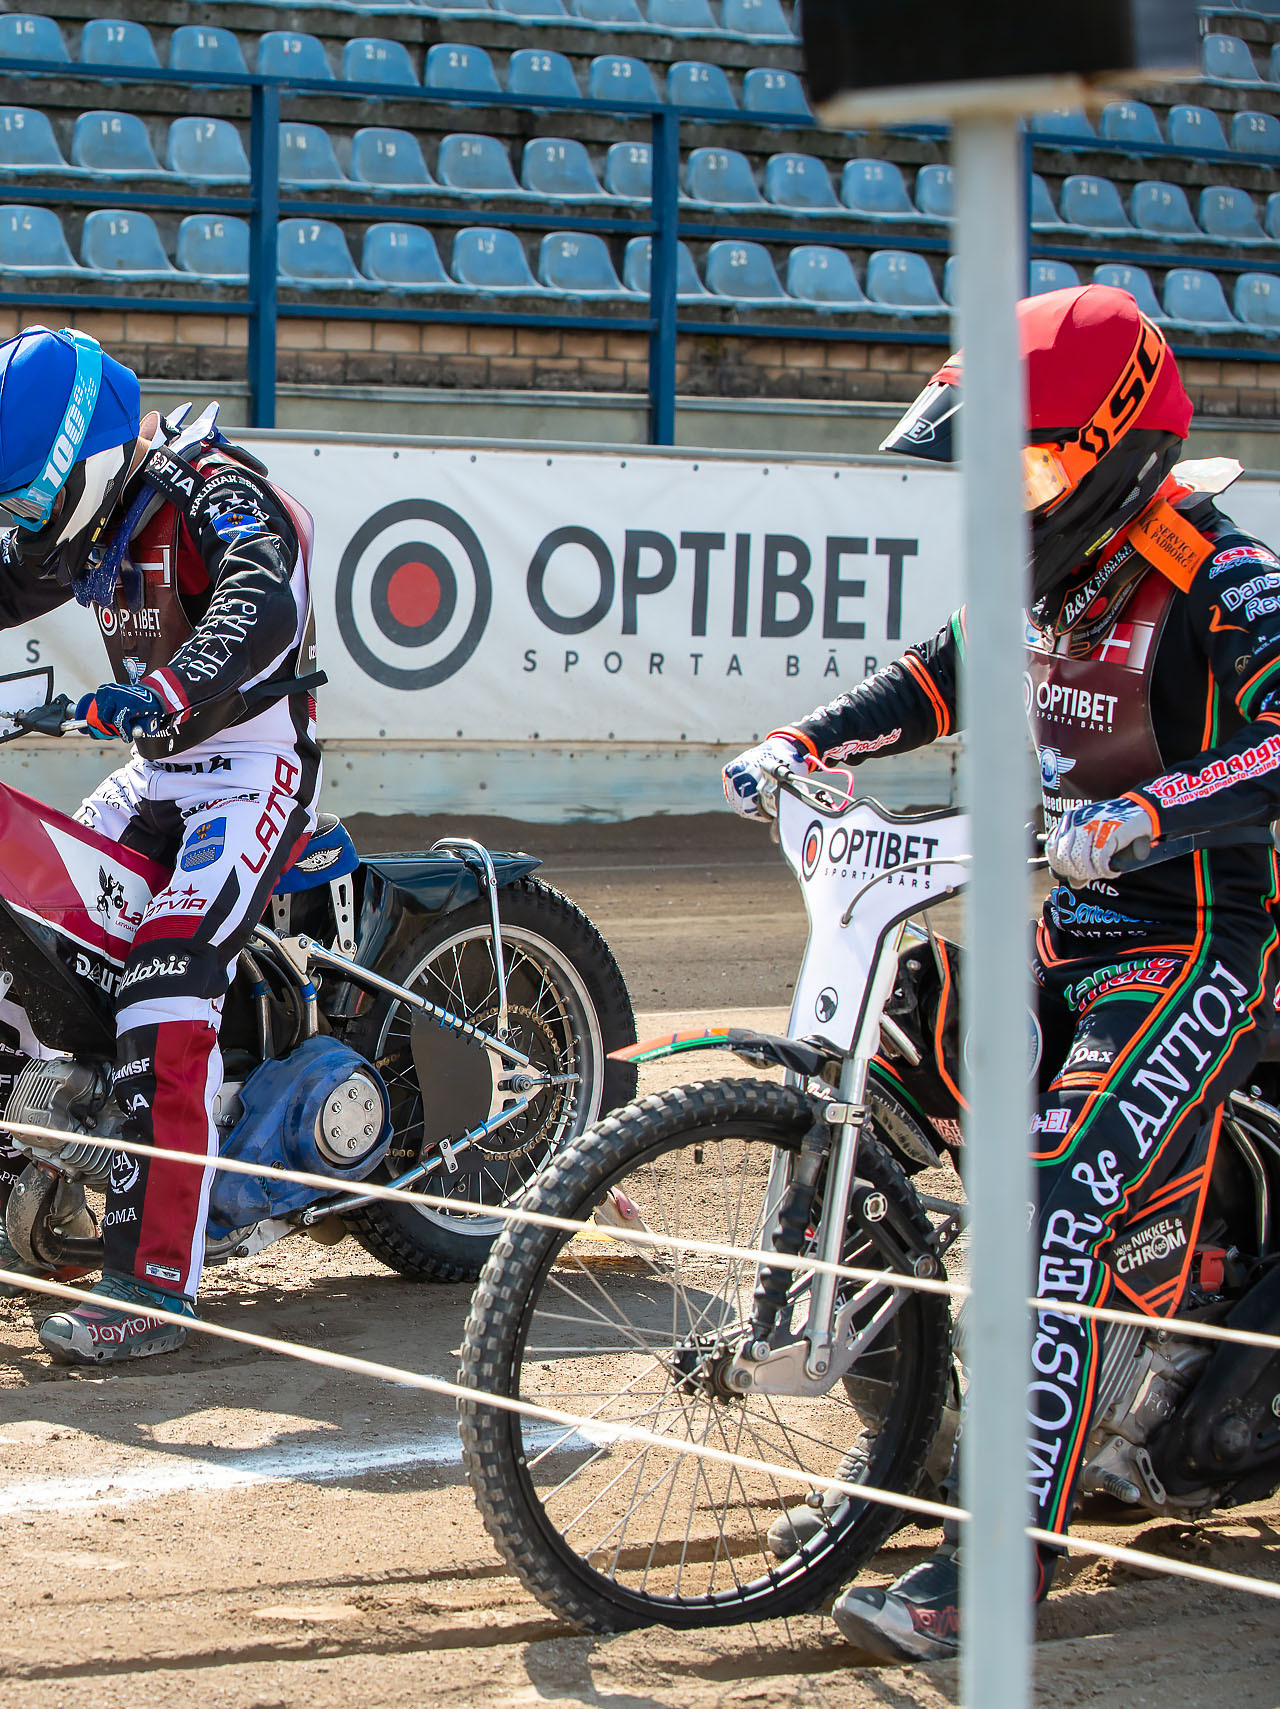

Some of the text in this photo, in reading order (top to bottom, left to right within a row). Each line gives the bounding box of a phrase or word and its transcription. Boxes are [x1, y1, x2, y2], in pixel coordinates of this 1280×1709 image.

[4, 115, 25, 131] 15
[195, 124, 216, 142] 17
[546, 147, 565, 161] 21
[11, 216, 32, 231] 14
[110, 221, 129, 235] 15
[298, 225, 320, 244] 17
[1150, 530, 1195, 569] PADBORG
[1156, 521, 1197, 561] SERVICE
[527, 525, 919, 640] OPTIBET
[523, 648, 878, 677] SPORTA BĀR
[1036, 682, 1118, 724] OPTIBET
[1036, 711, 1072, 725] SPORTA
[829, 827, 939, 876] OPTIBET
[1075, 1150, 1124, 1207] &
[1131, 1218, 1183, 1248] NIKKEL &
[1116, 1228, 1187, 1274] CHROM
